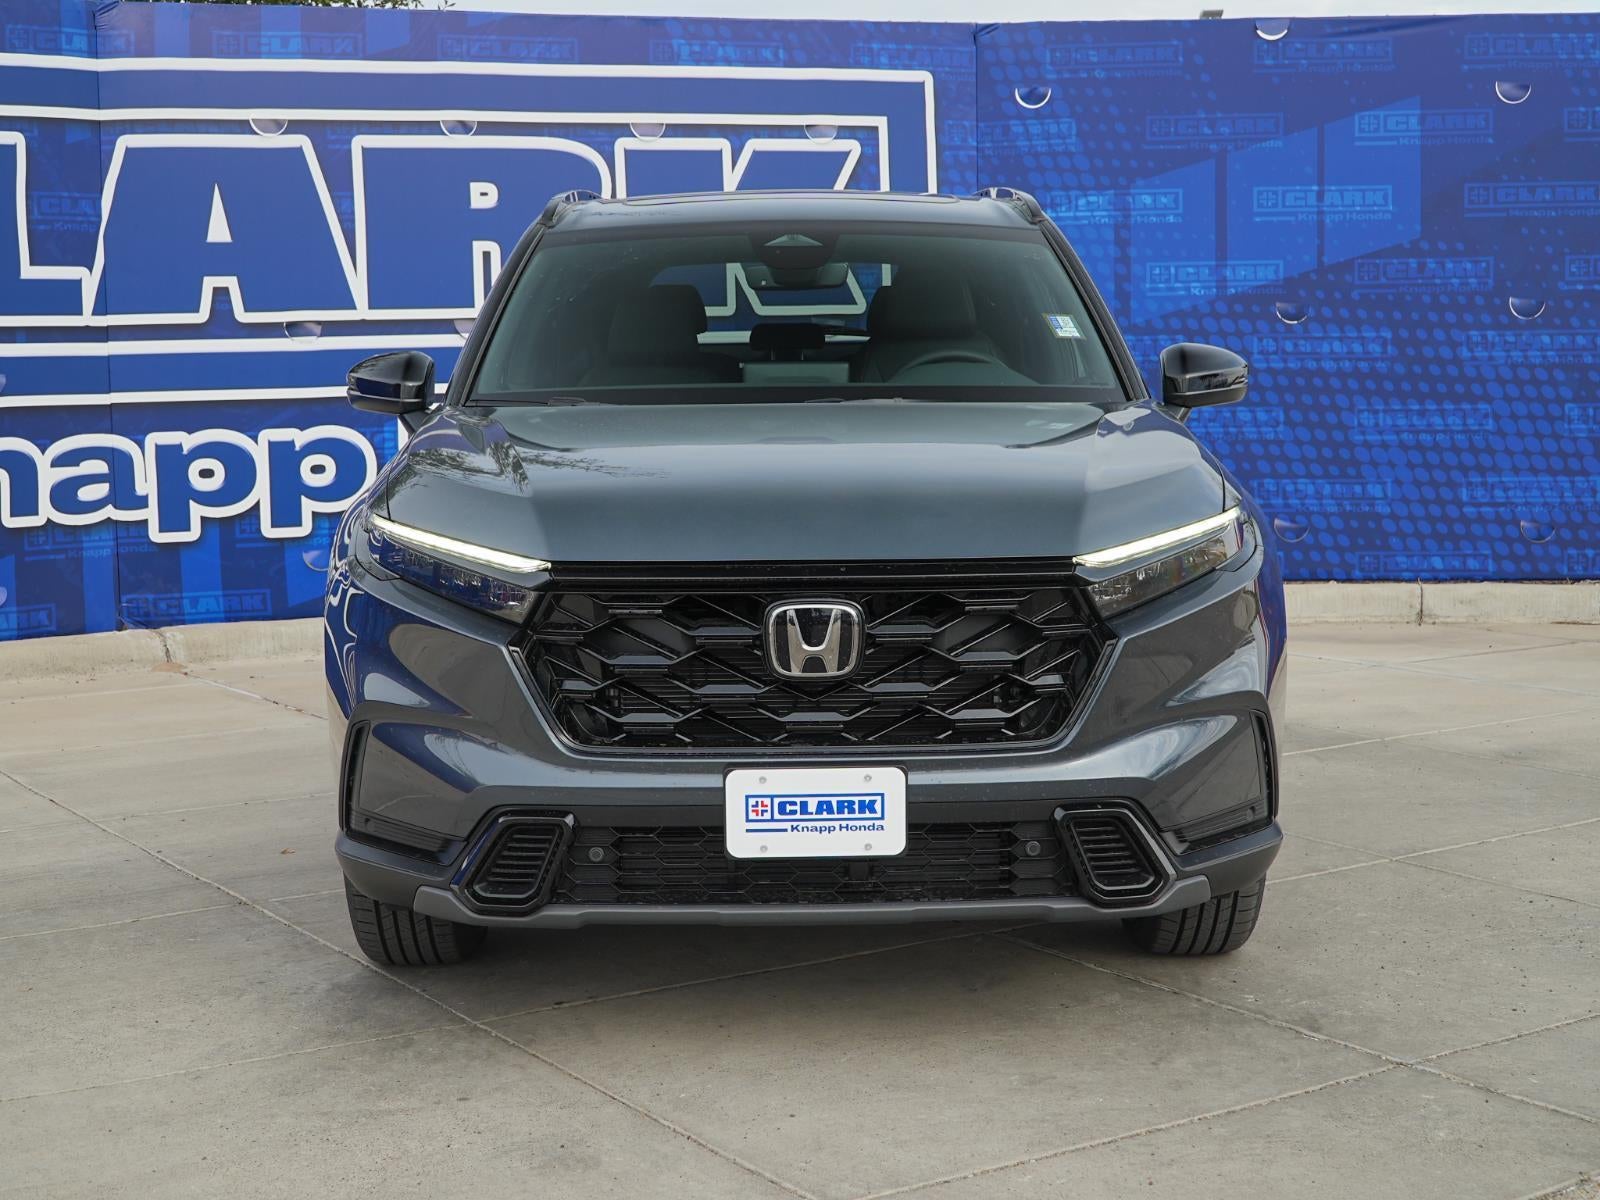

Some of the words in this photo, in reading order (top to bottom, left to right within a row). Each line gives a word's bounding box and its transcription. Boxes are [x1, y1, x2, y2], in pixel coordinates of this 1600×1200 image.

[1285, 42, 1389, 60] CLARK
[1178, 118, 1278, 137] CLARK
[1386, 113, 1487, 131] CLARK
[1076, 191, 1177, 210] CLARK
[1285, 189, 1386, 207] CLARK
[1497, 186, 1596, 203] CLARK
[1137, 213, 1183, 223] Honda
[1298, 212, 1343, 223] Knapp
[1346, 211, 1392, 221] Honda
[1178, 263, 1278, 282] CLARK
[1386, 260, 1487, 279] CLARK
[118, 543, 158, 554] onda
[153, 593, 267, 616] CLARK
[777, 799, 877, 816] CLARK
[790, 823, 836, 834] Knapp
[838, 823, 884, 832] Honda
